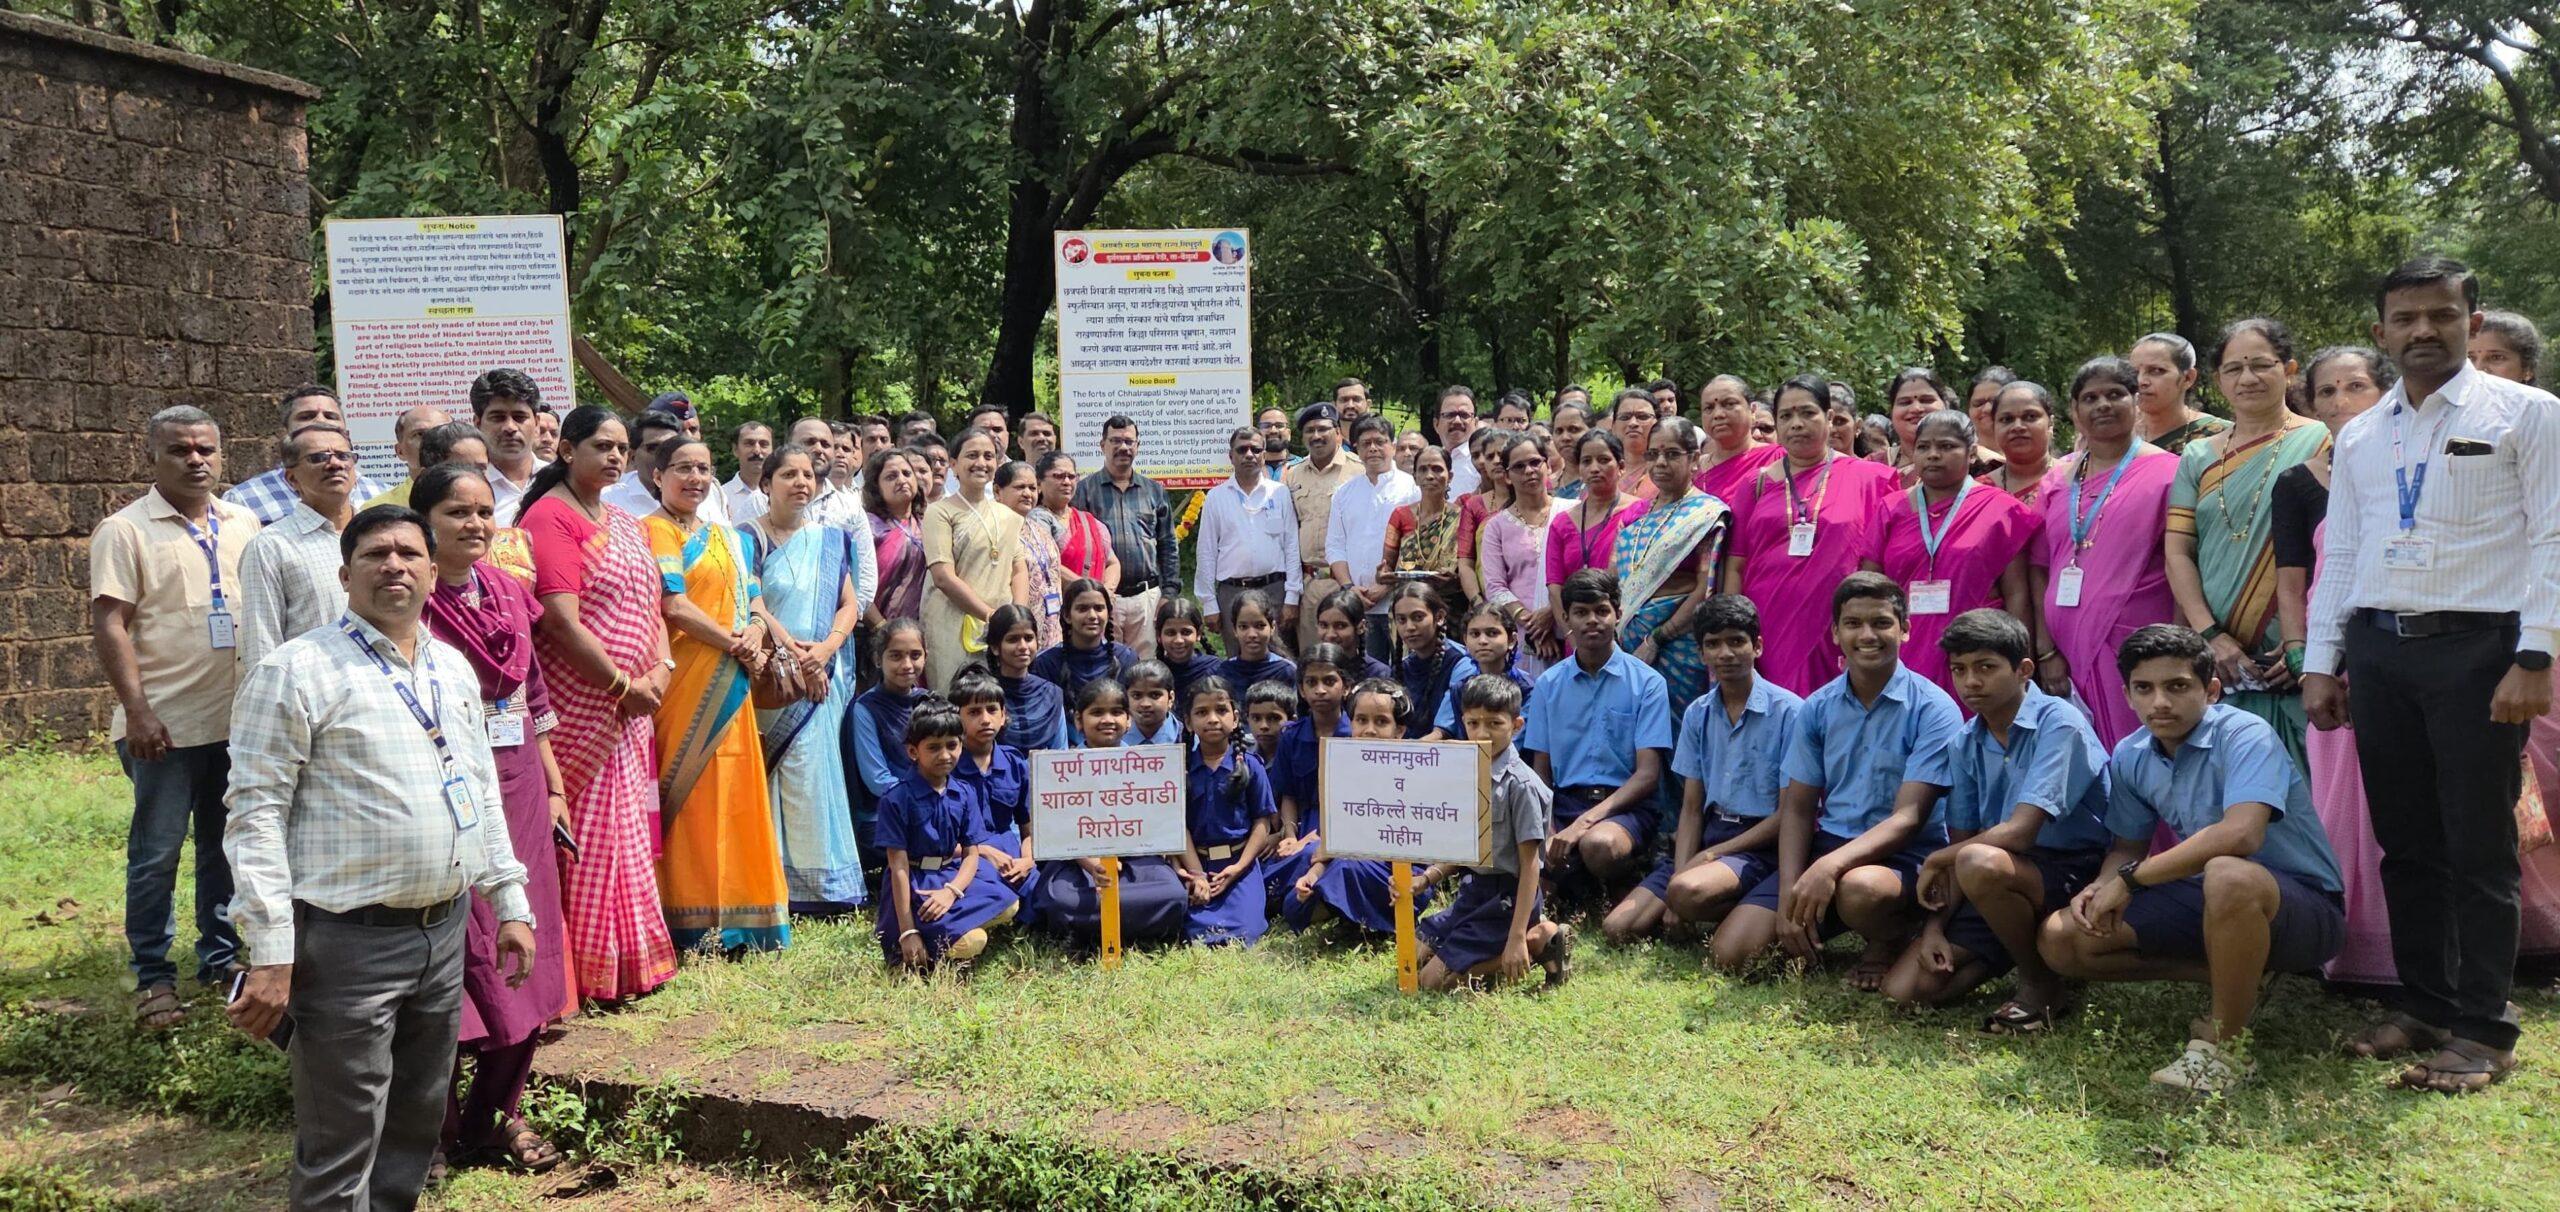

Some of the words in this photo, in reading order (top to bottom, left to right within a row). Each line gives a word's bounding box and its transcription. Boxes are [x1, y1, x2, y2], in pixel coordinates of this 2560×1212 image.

[1051, 753, 1084, 782] पूर्ण
[1089, 751, 1165, 776] प्राथमिक
[1361, 747, 1440, 769] व्यसनमुक्ती
[1041, 791, 1093, 809] शाळा
[1099, 780, 1177, 806] खर्डेवाडी
[1394, 778, 1405, 791] व
[1343, 797, 1406, 819] गडकिल्ले
[1411, 802, 1458, 822] संवर्धन
[1077, 814, 1143, 838] शिरोडा
[1378, 825, 1423, 846] मोहीम
